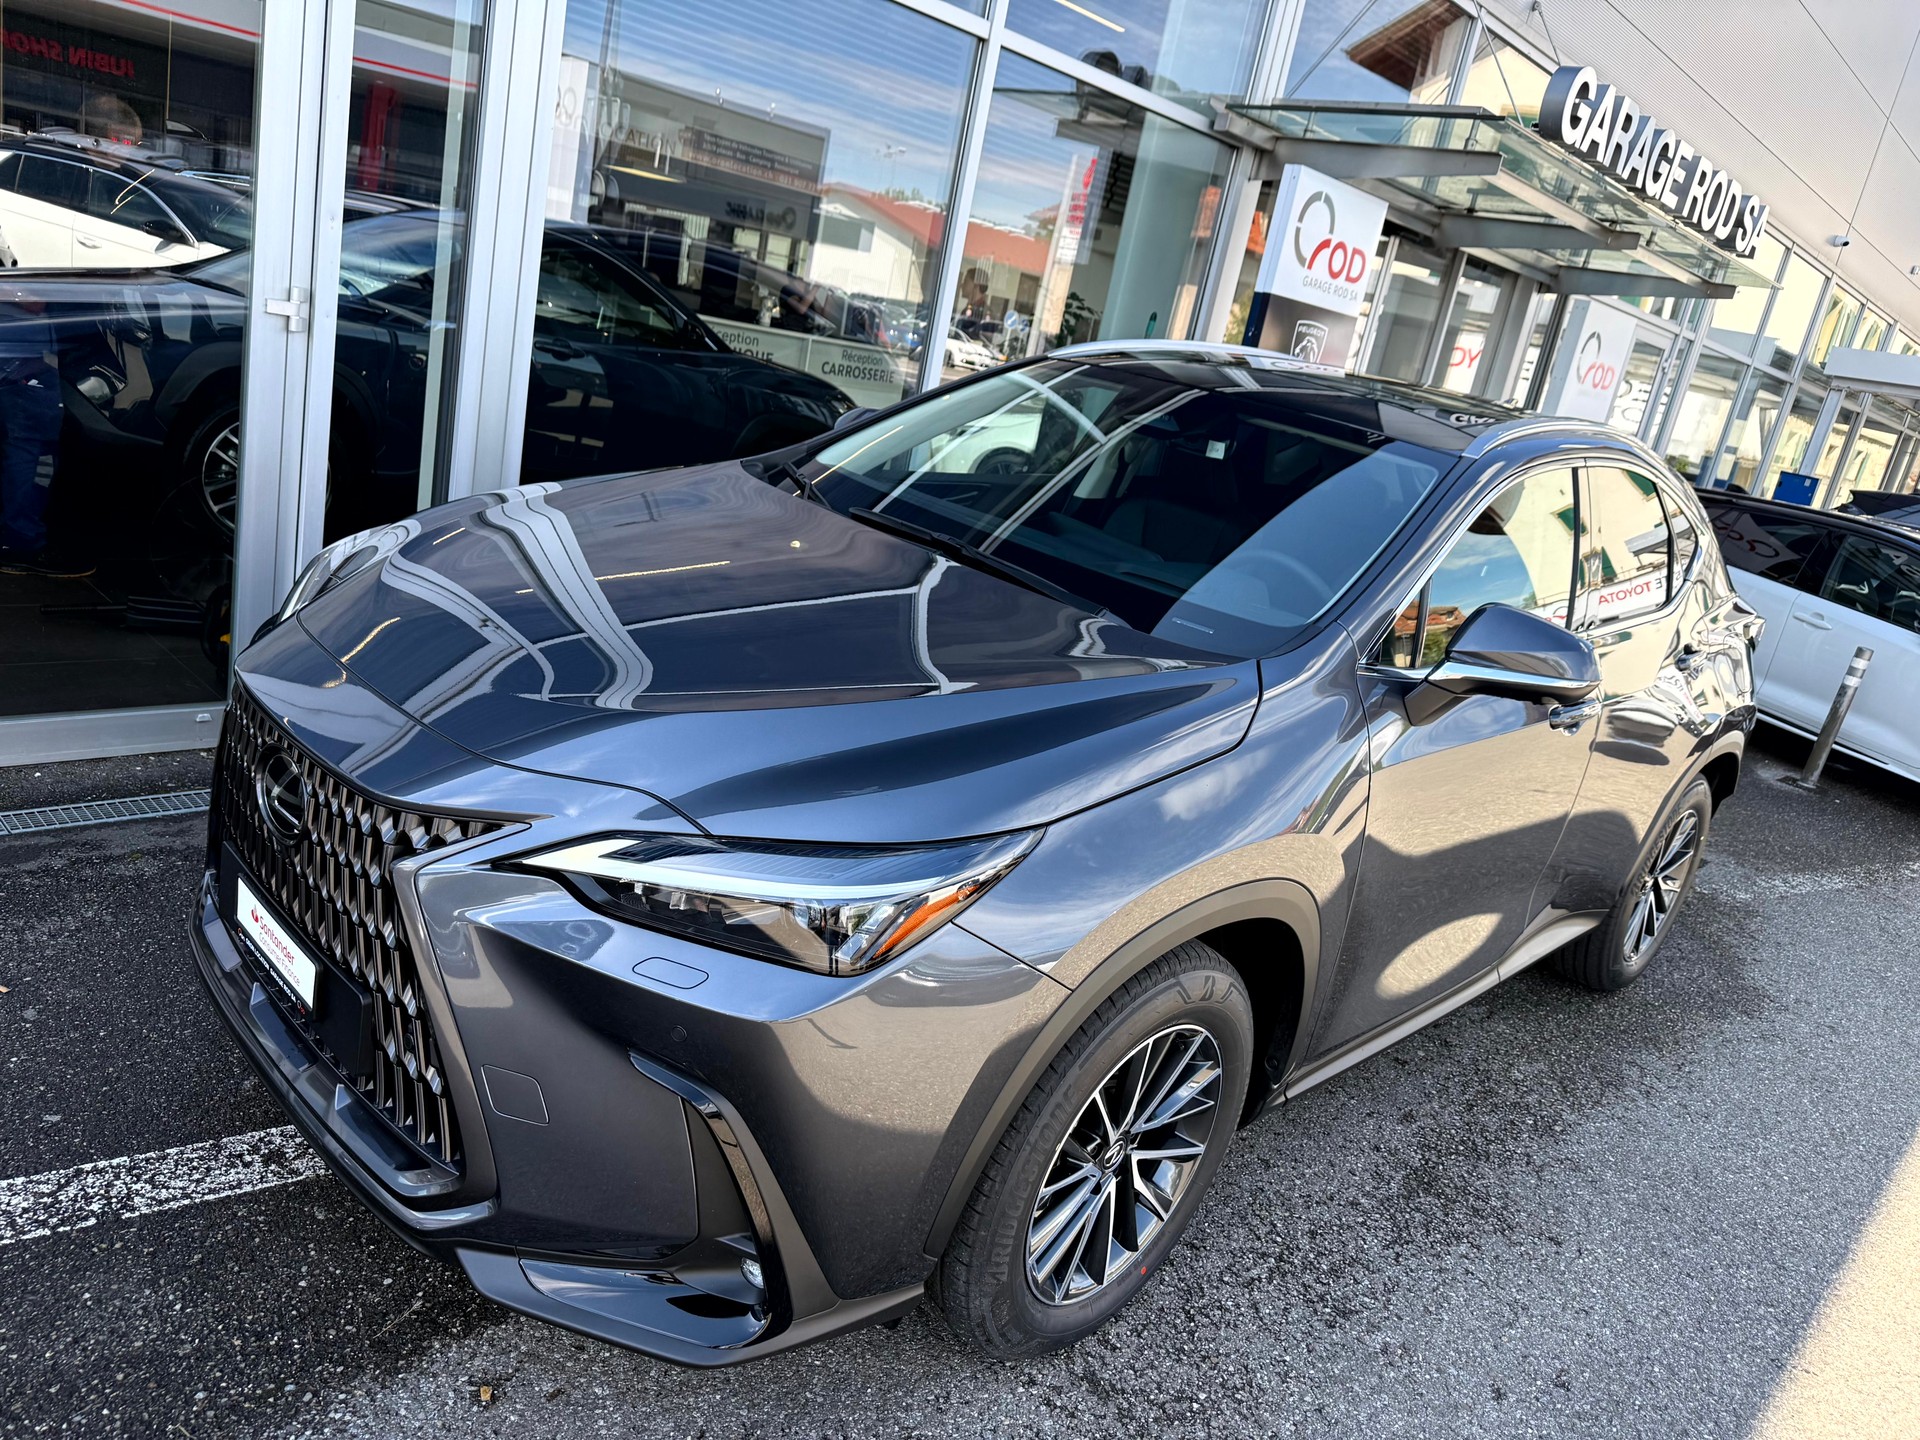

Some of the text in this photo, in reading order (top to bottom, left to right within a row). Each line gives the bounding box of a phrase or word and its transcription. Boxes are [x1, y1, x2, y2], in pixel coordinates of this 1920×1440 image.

[1561, 66, 1770, 257] GARAGE ROD SA
[1302, 275, 1358, 302] GARAGE ROD SA
[1298, 325, 1324, 338] PEUGEOT
[842, 350, 883, 367] Réception
[821, 361, 895, 384] CARROSSERIE
[259, 915, 295, 966] Santander
